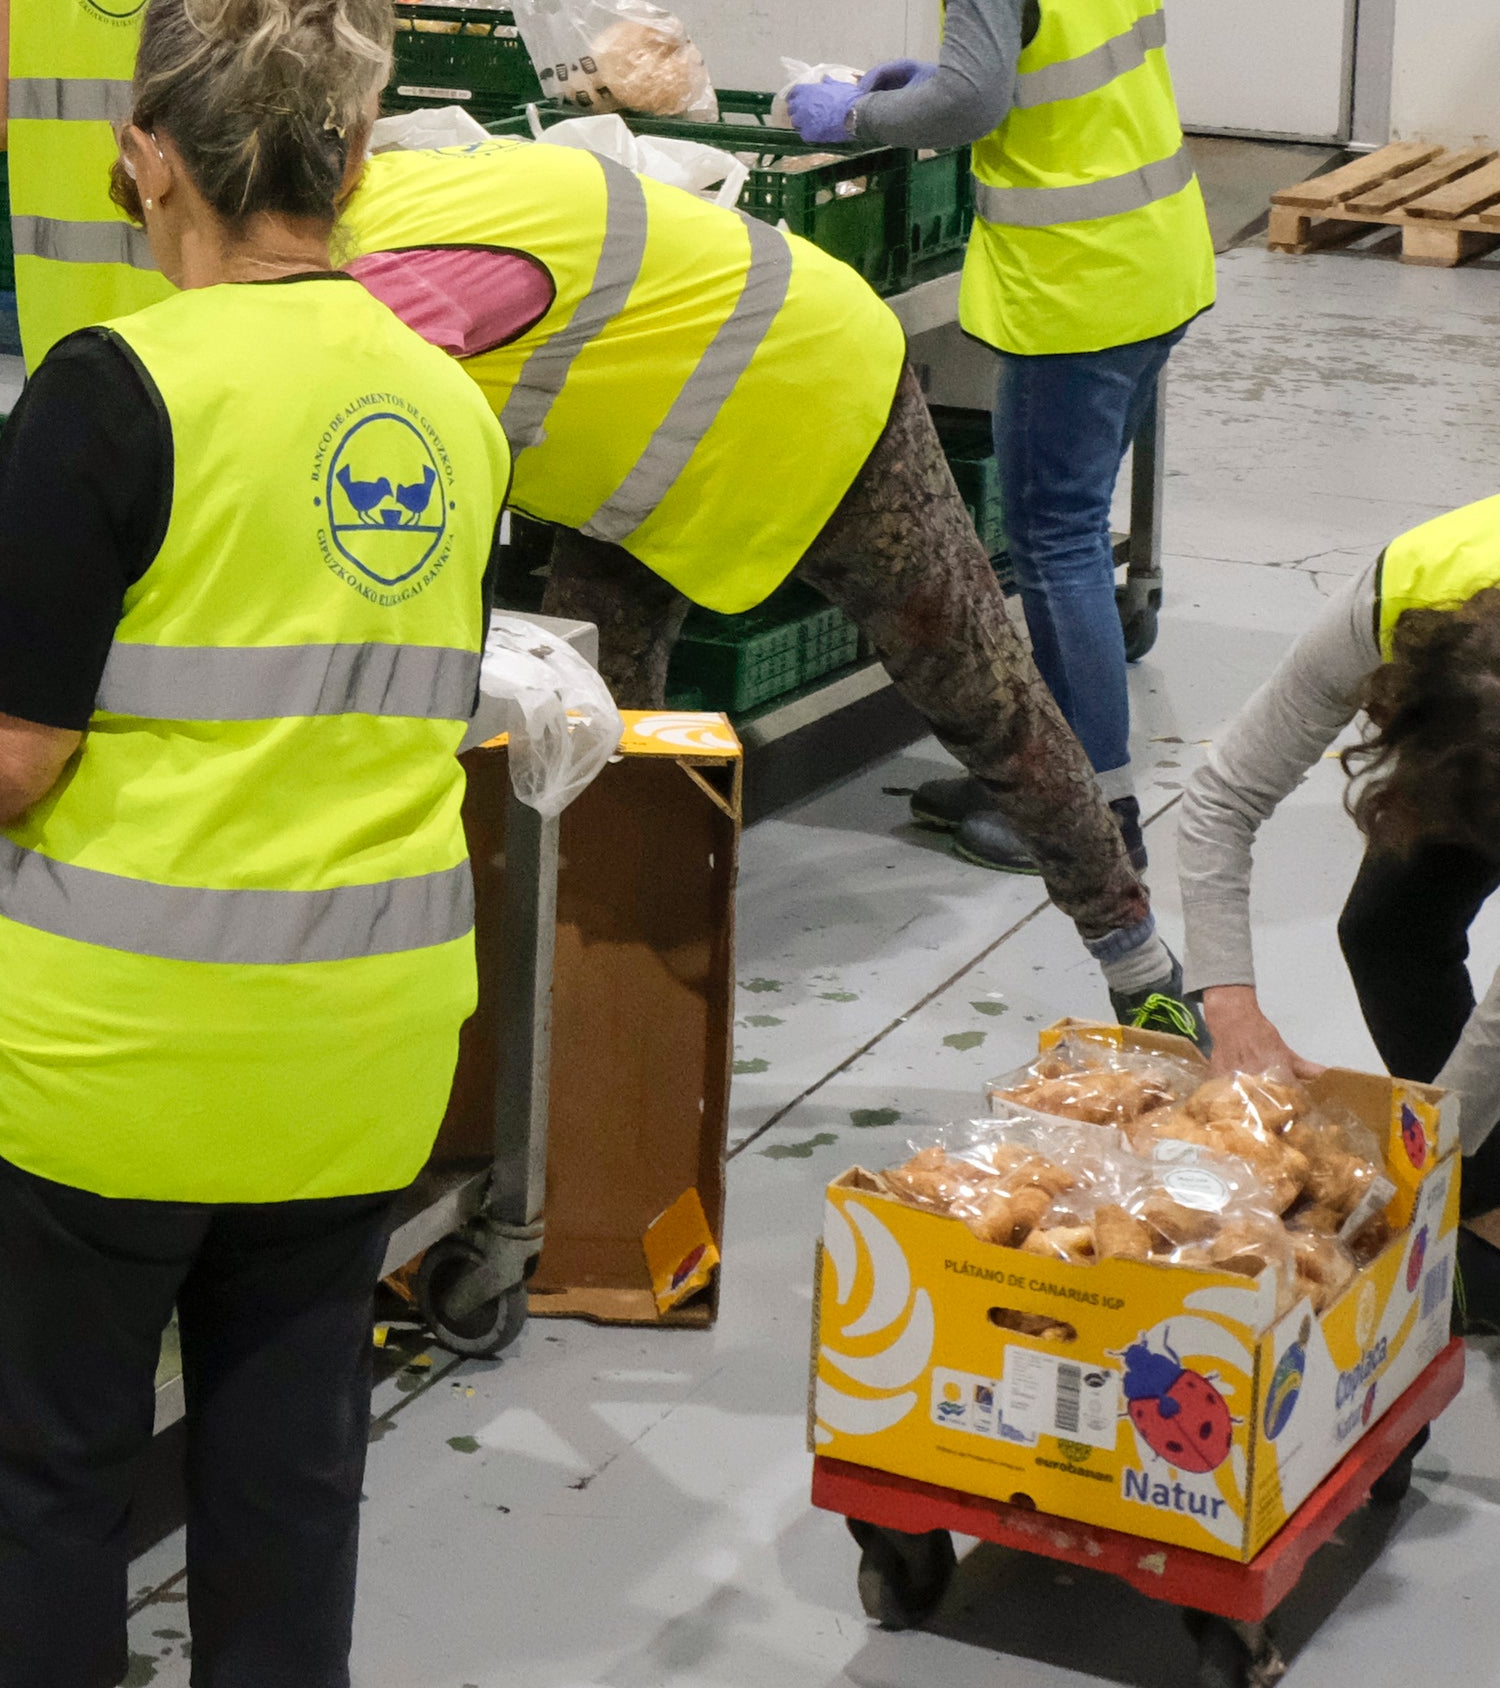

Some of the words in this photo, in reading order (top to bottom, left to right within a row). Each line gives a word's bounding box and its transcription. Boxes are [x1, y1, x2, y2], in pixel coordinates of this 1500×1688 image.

[311, 431, 333, 482] BANCO
[329, 413, 345, 432] DE
[344, 393, 406, 419] ALIMENTOS
[406, 402, 419, 419] DE
[419, 416, 456, 486] GIPUZKOA
[316, 528, 378, 604] GIPUZKOAKO
[944, 1259, 1005, 1285] PLÁTANO
[1007, 1274, 1026, 1289] DE
[1028, 1279, 1100, 1306] CANARIAS
[1102, 1297, 1126, 1310] IGP
[1034, 1456, 1114, 1483] eurobanan
[1124, 1467, 1225, 1520] Natur
